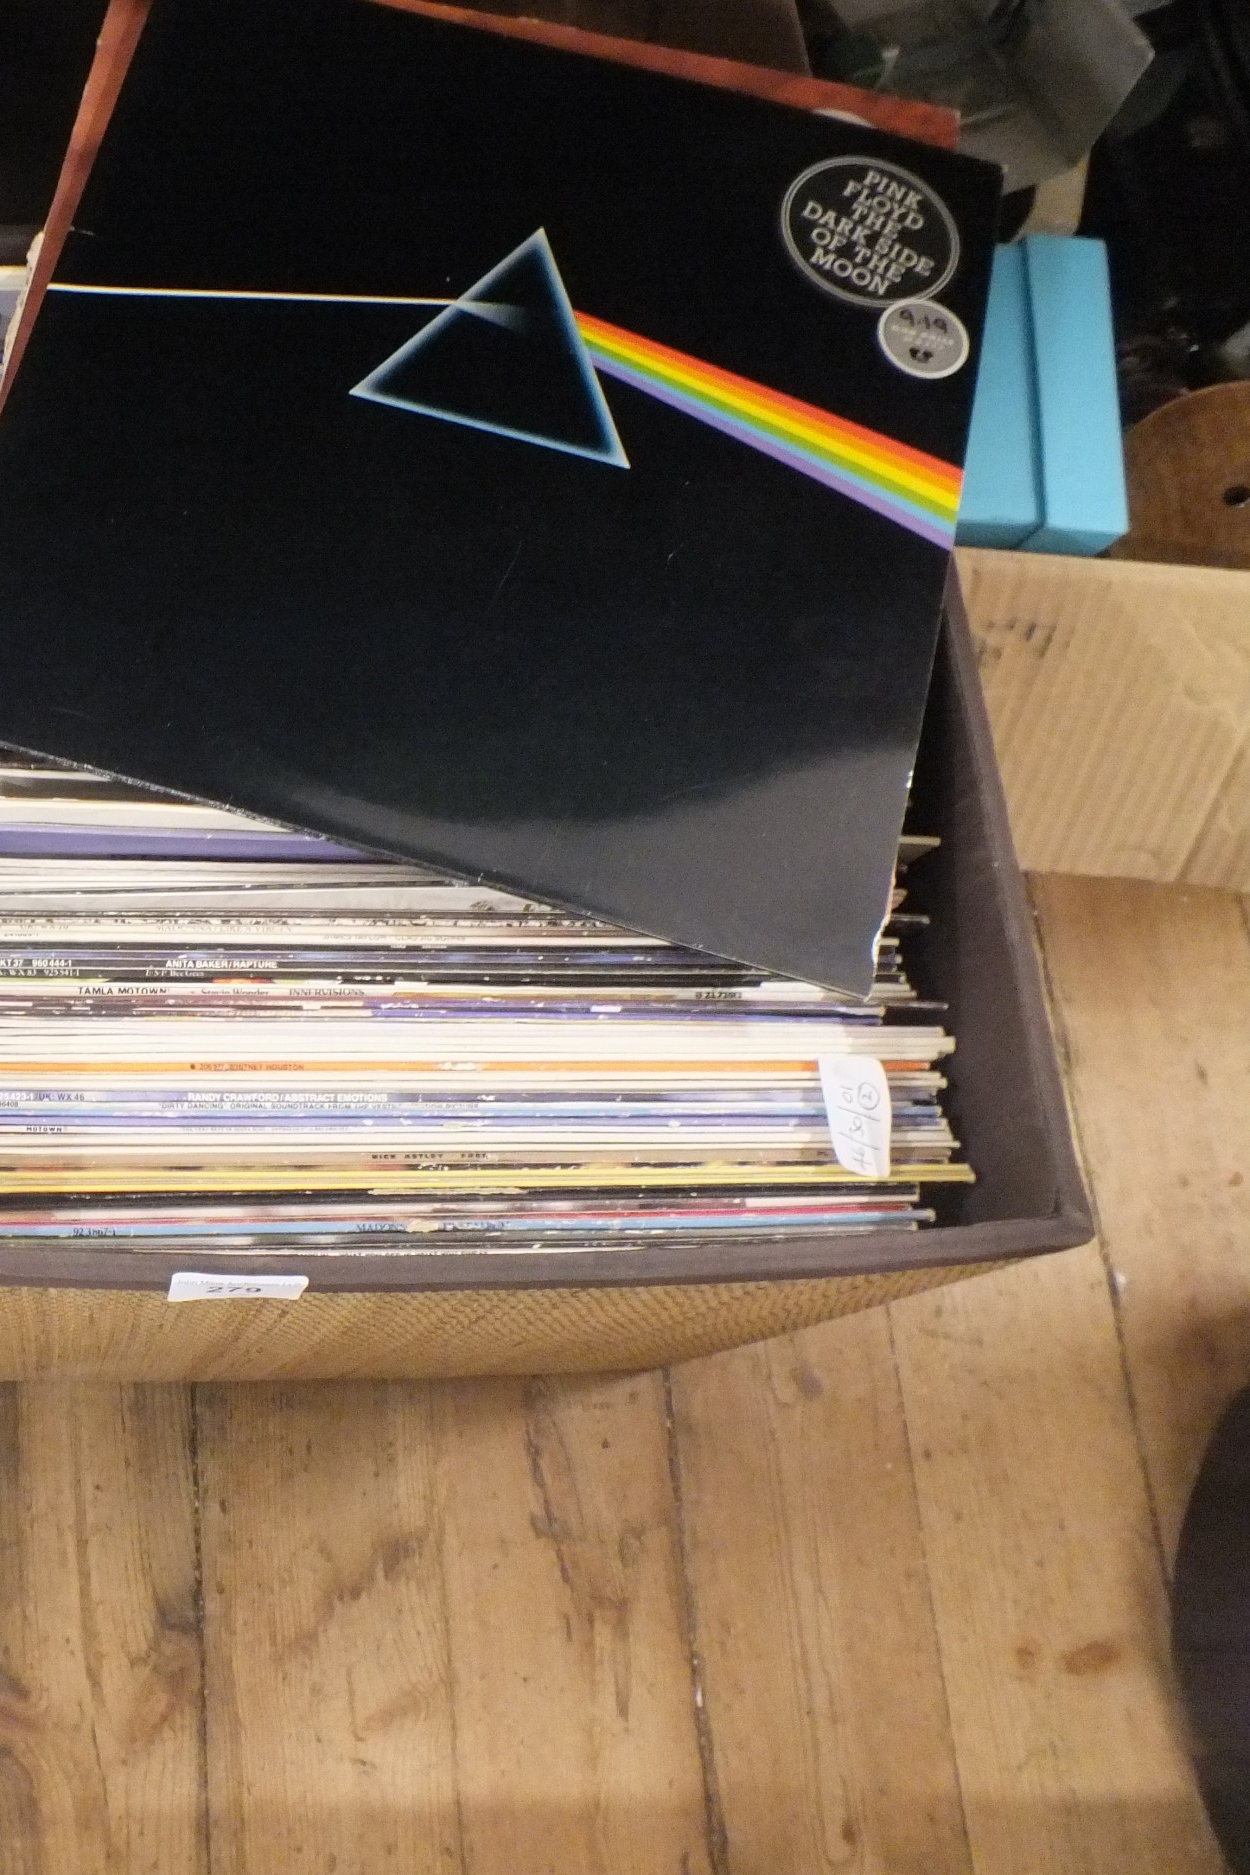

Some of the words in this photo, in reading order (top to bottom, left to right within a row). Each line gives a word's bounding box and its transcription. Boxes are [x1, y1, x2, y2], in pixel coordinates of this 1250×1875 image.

[843, 179, 923, 230] FLOYD
[863, 170, 922, 210] PINK
[802, 200, 871, 246] DARK
[875, 238, 935, 276] SIDE
[852, 204, 902, 240] THE
[810, 246, 891, 295] MOON
[811, 226, 848, 251] OF
[855, 245, 906, 283] THE
[166, 960, 194, 968] ANITA
[78, 987, 113, 995] TAMLA
[118, 987, 167, 995] MOTOWN
[290, 988, 365, 996] INNERVISIONS
[266, 1063, 304, 1071] HOUSTON
[187, 1093, 221, 1102] RANDY
[337, 1093, 388, 1102] EMOTIONS
[271, 1102, 325, 1110] SOUNDTRACK
